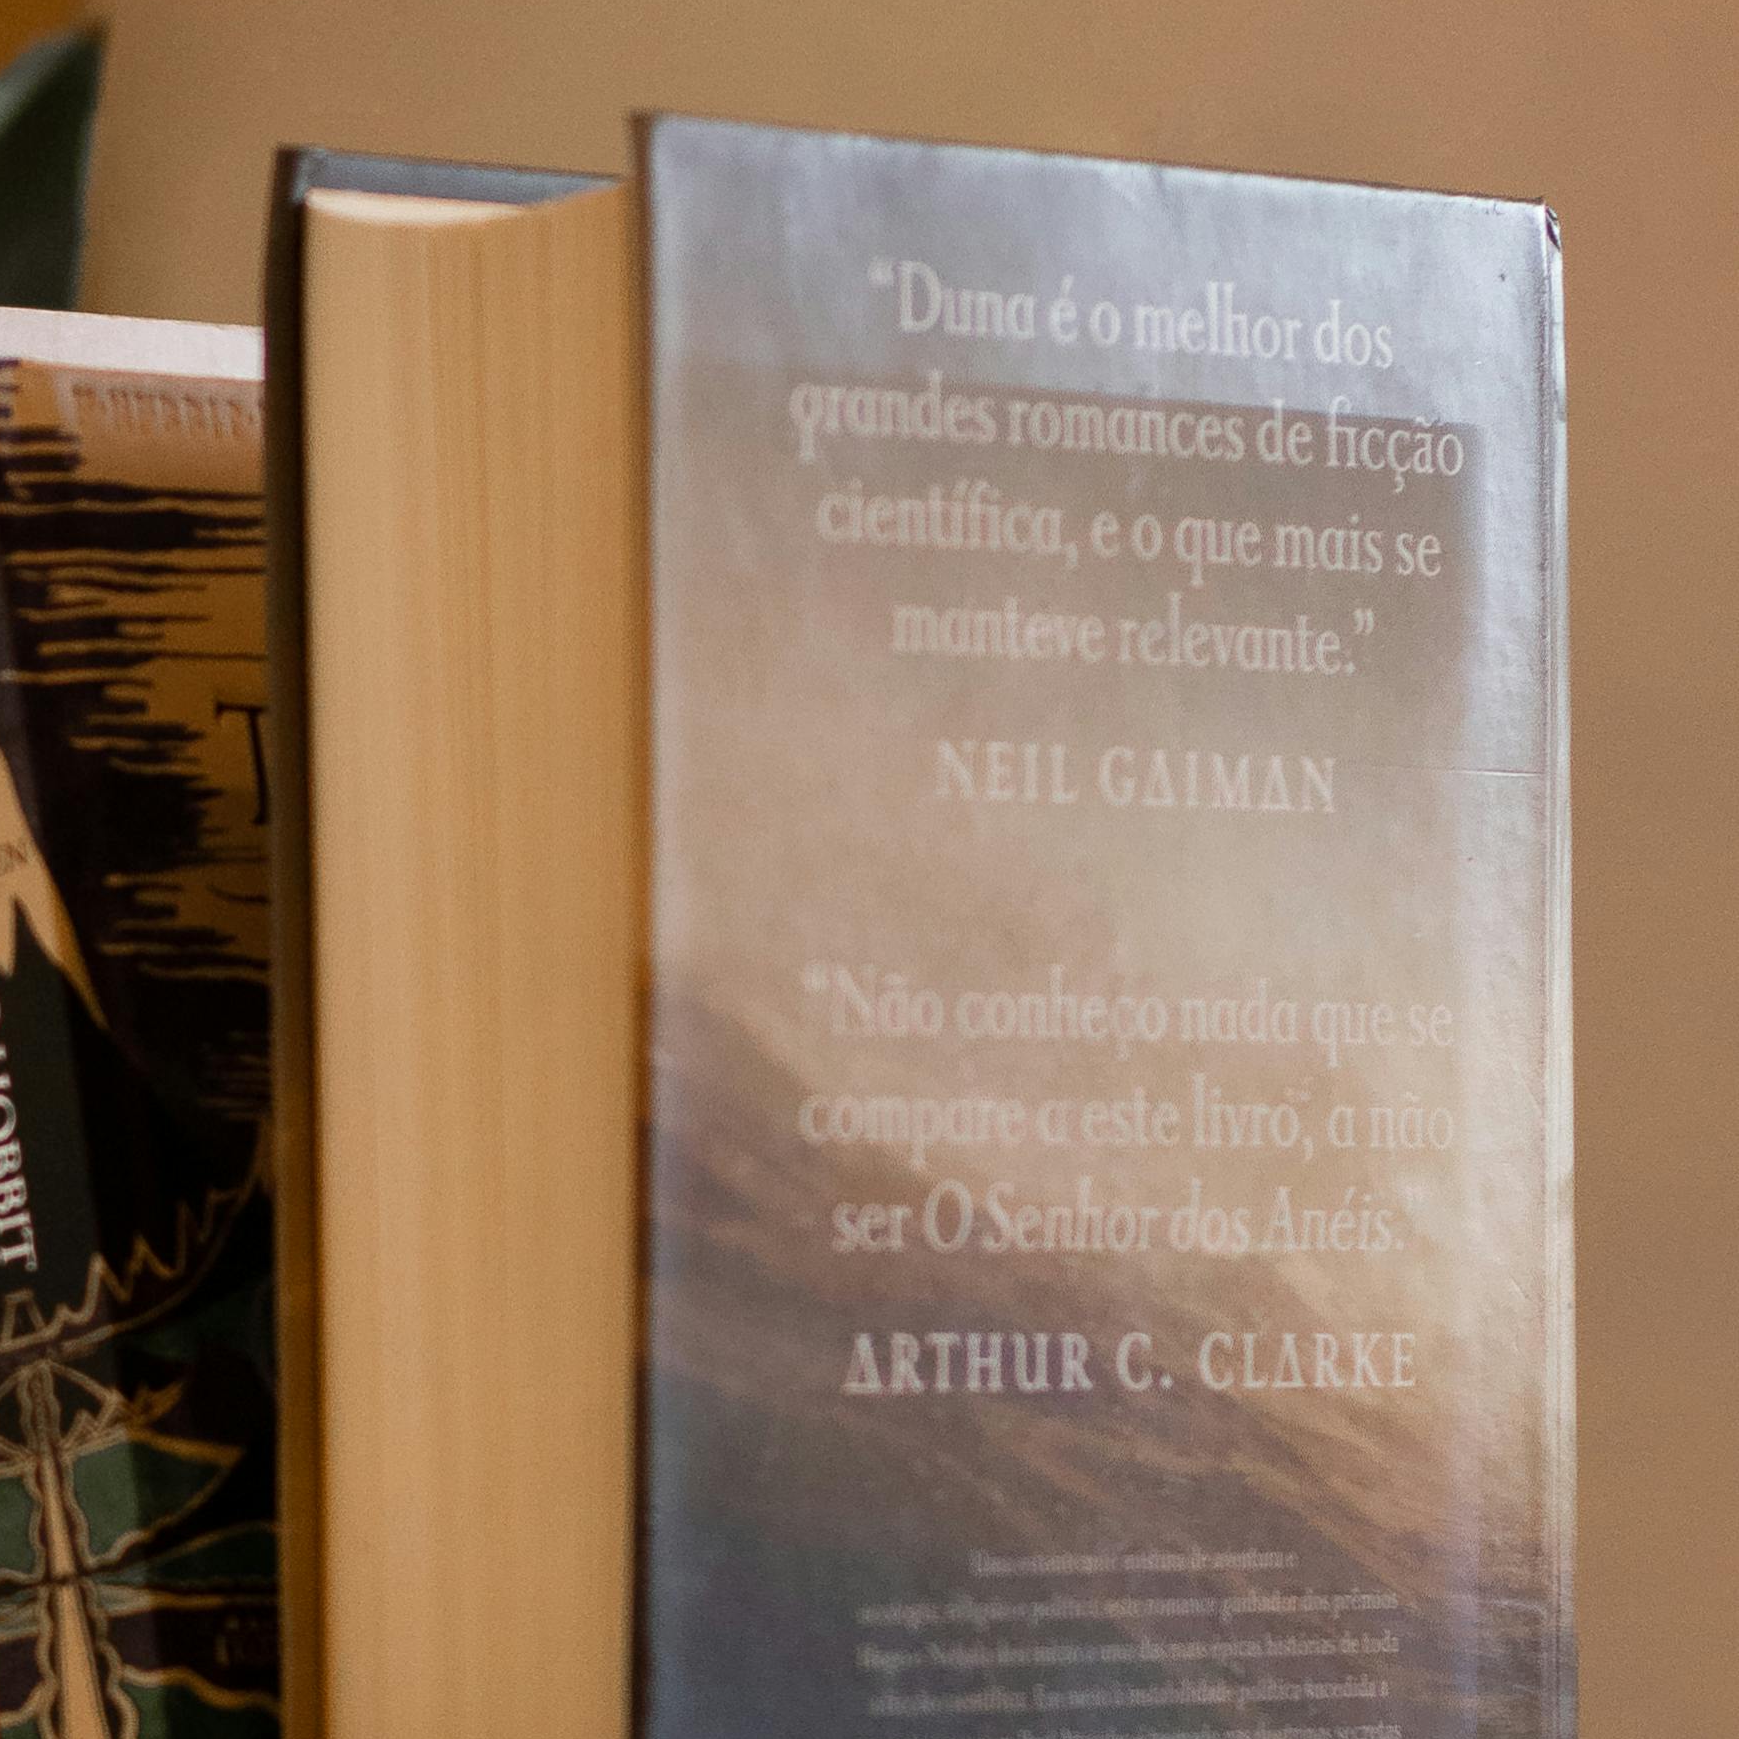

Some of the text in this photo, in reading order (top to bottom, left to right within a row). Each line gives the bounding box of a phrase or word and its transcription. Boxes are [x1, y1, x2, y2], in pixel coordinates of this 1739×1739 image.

[1050, 277, 1078, 344] é
[1089, 295, 1121, 347] o
[1133, 280, 1302, 363] melhor
[1314, 300, 1393, 368] dos
[789, 368, 1463, 493] grandes romances de ficção
[816, 477, 1443, 587] científica, e o que mais se
[892, 590, 1376, 677] manteve relevante.”
[933, 735, 1338, 816] NEIL GAIMAN
[955, 962, 1170, 1059] conheço
[1178, 978, 1299, 1049] nada
[1310, 991, 1394, 1069] que
[1406, 997, 1455, 1051] se
[799, 1071, 1455, 1171] compare a este livro, a não
[831, 1200, 912, 1254] ser
[923, 1177, 977, 1248] O
[982, 1177, 1162, 1252] Senhor
[1169, 1179, 1252, 1252] dos
[841, 1329, 1419, 1397] ARTHUR C. CLARKE
